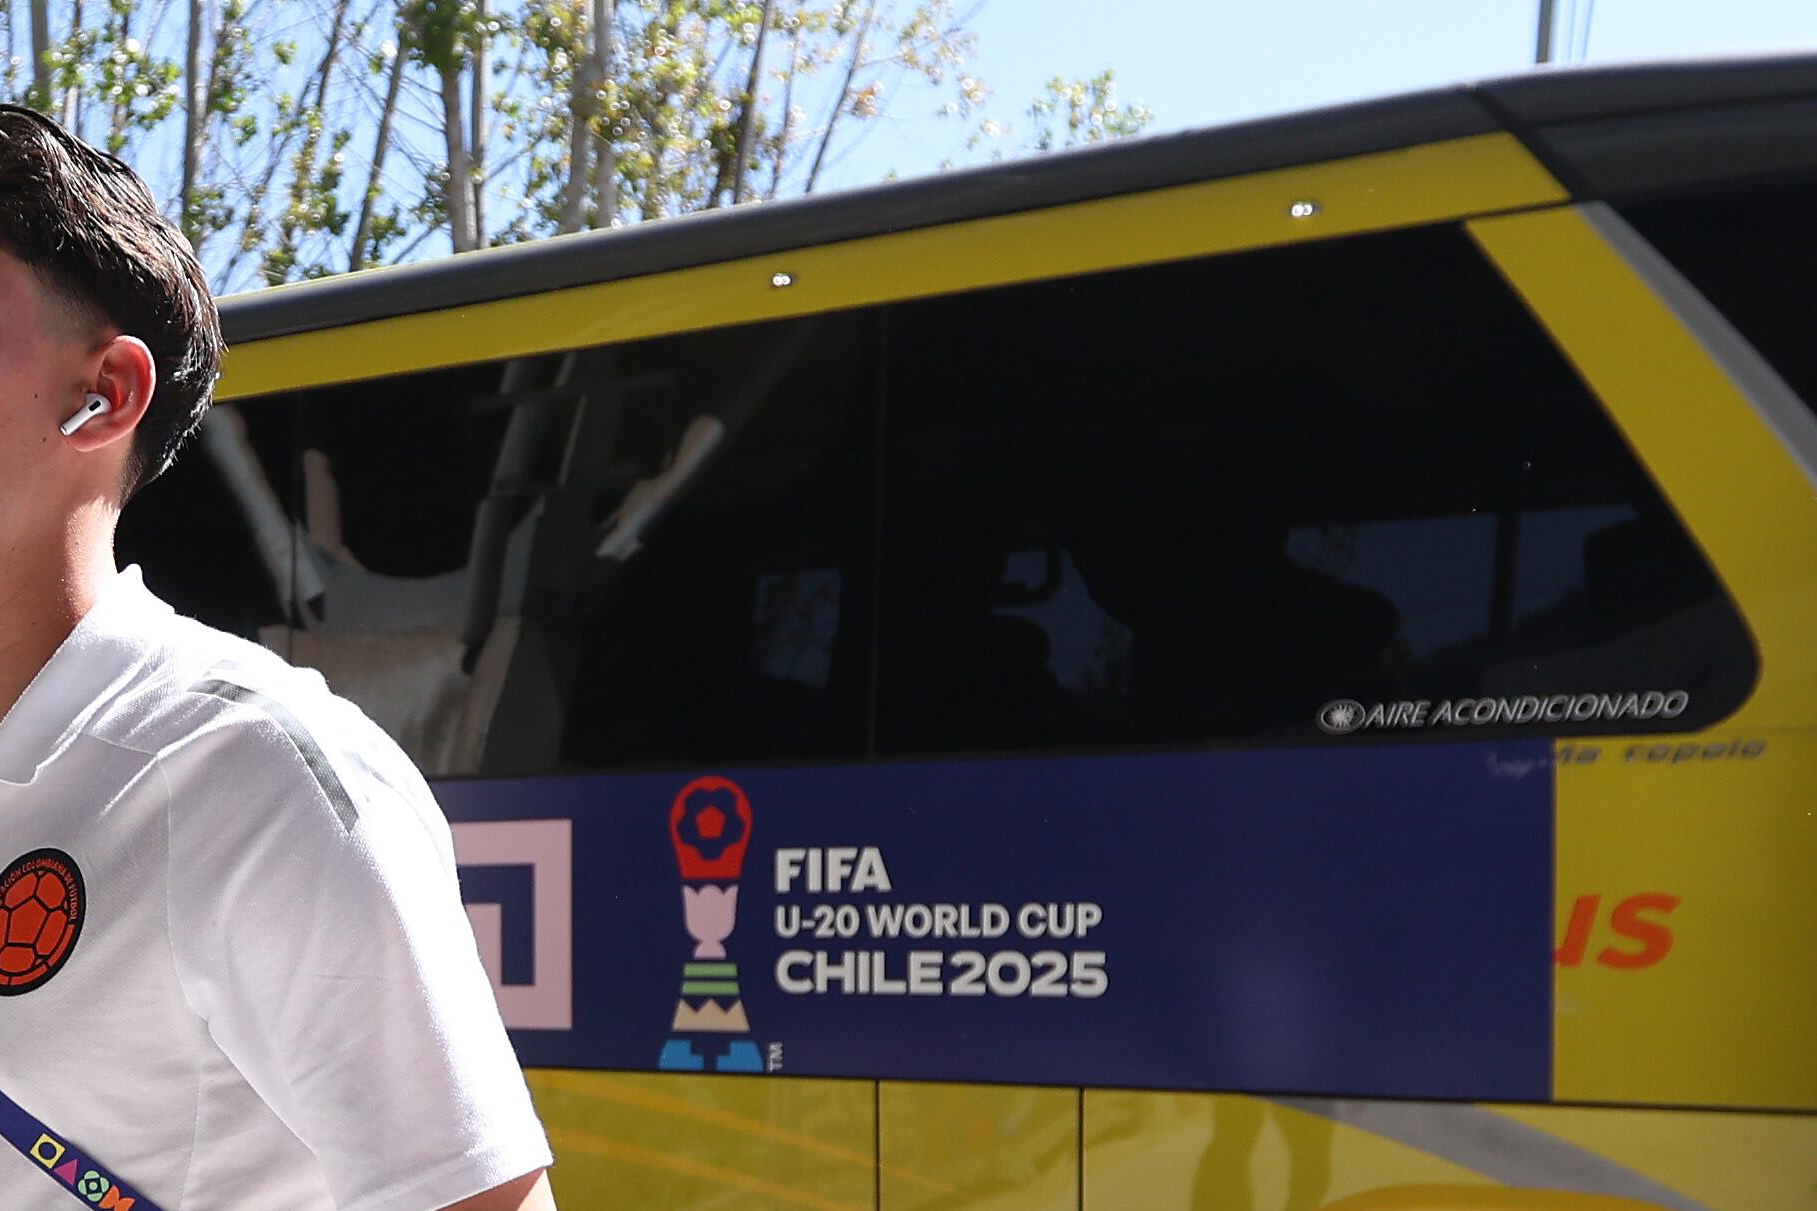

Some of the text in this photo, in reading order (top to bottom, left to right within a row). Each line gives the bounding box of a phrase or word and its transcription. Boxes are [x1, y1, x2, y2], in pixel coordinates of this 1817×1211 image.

[1364, 689, 1690, 729] AIRE ACONDICIONADO
[775, 847, 892, 894] FIFA
[775, 902, 1103, 939] U-20 WORLD CUP
